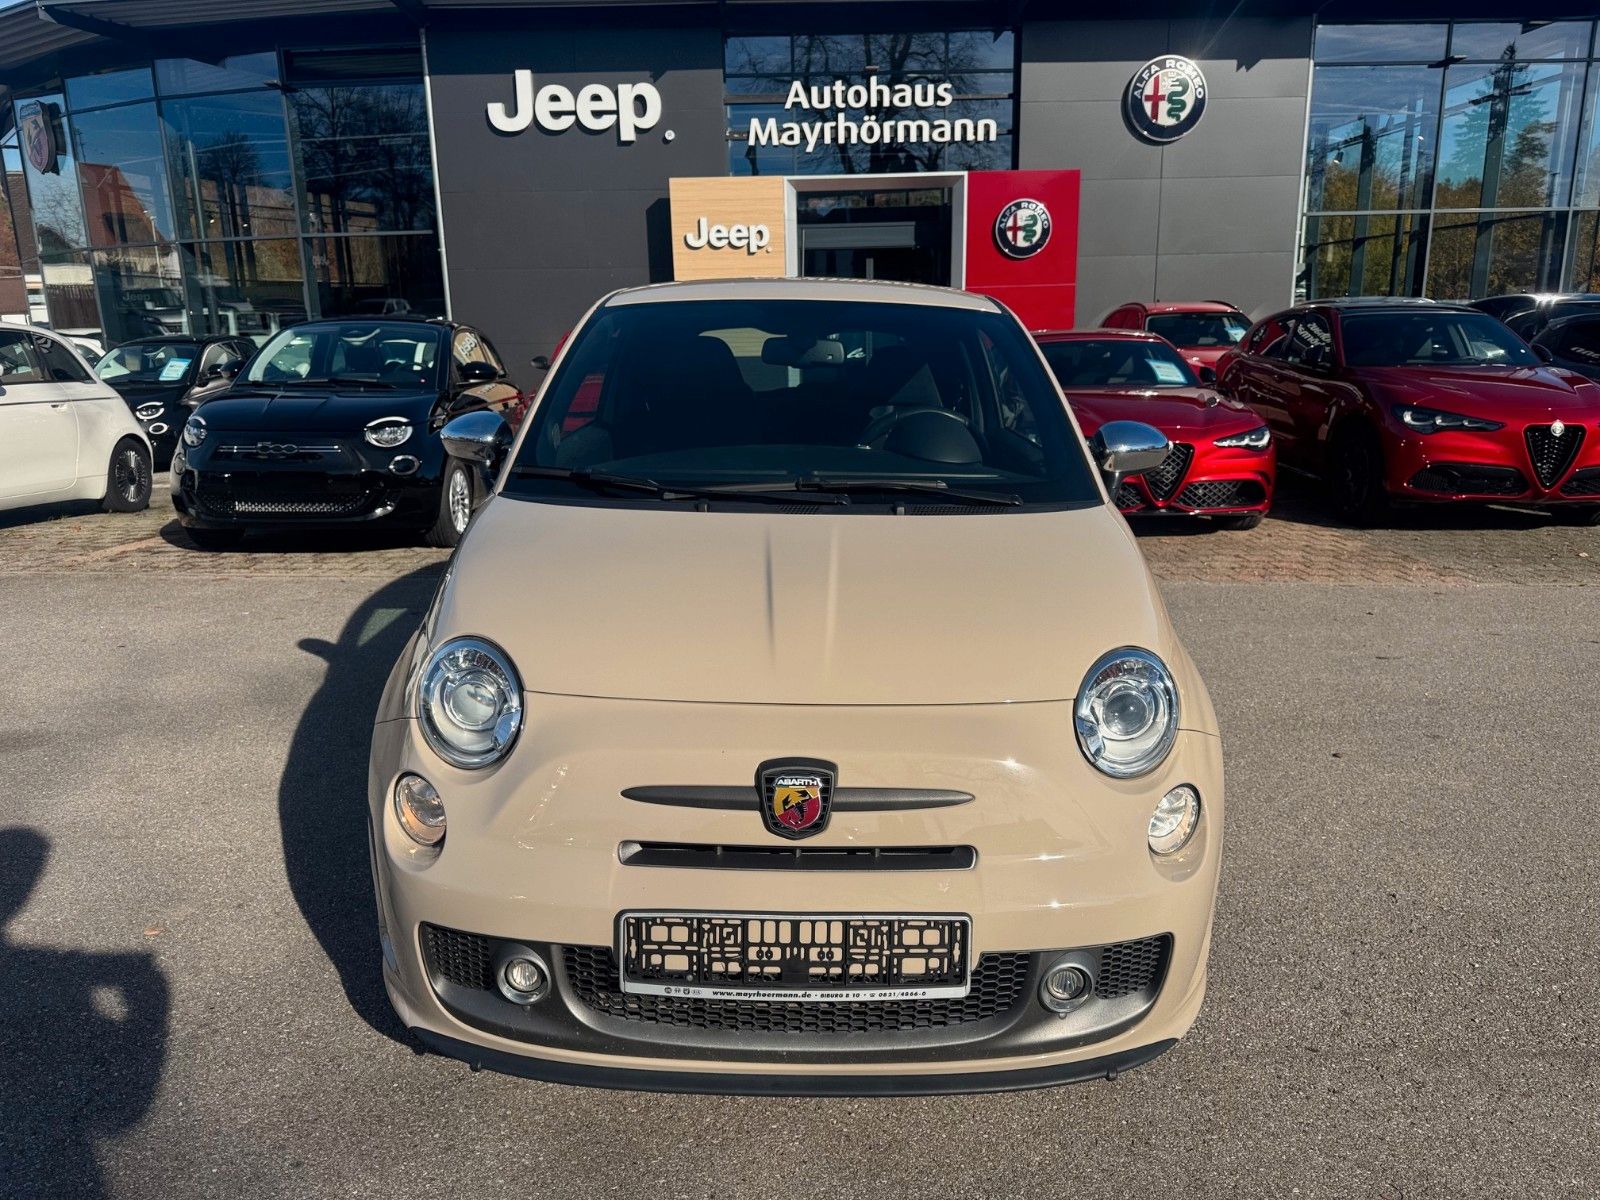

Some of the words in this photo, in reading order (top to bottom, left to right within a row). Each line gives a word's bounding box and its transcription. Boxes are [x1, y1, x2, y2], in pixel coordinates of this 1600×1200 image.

[784, 76, 953, 109] Autohaus
[1133, 64, 1160, 99] ALFA
[1165, 59, 1204, 99] ROMEO
[487, 69, 662, 141] Jeep
[748, 112, 997, 153] Mayrhörmann
[1000, 205, 1017, 229] ALFA
[1020, 201, 1049, 229] ROMEO
[685, 217, 770, 253] Jeep
[777, 778, 817, 786] ABARTH
[712, 990, 812, 998] www.mayrhoermann.de
